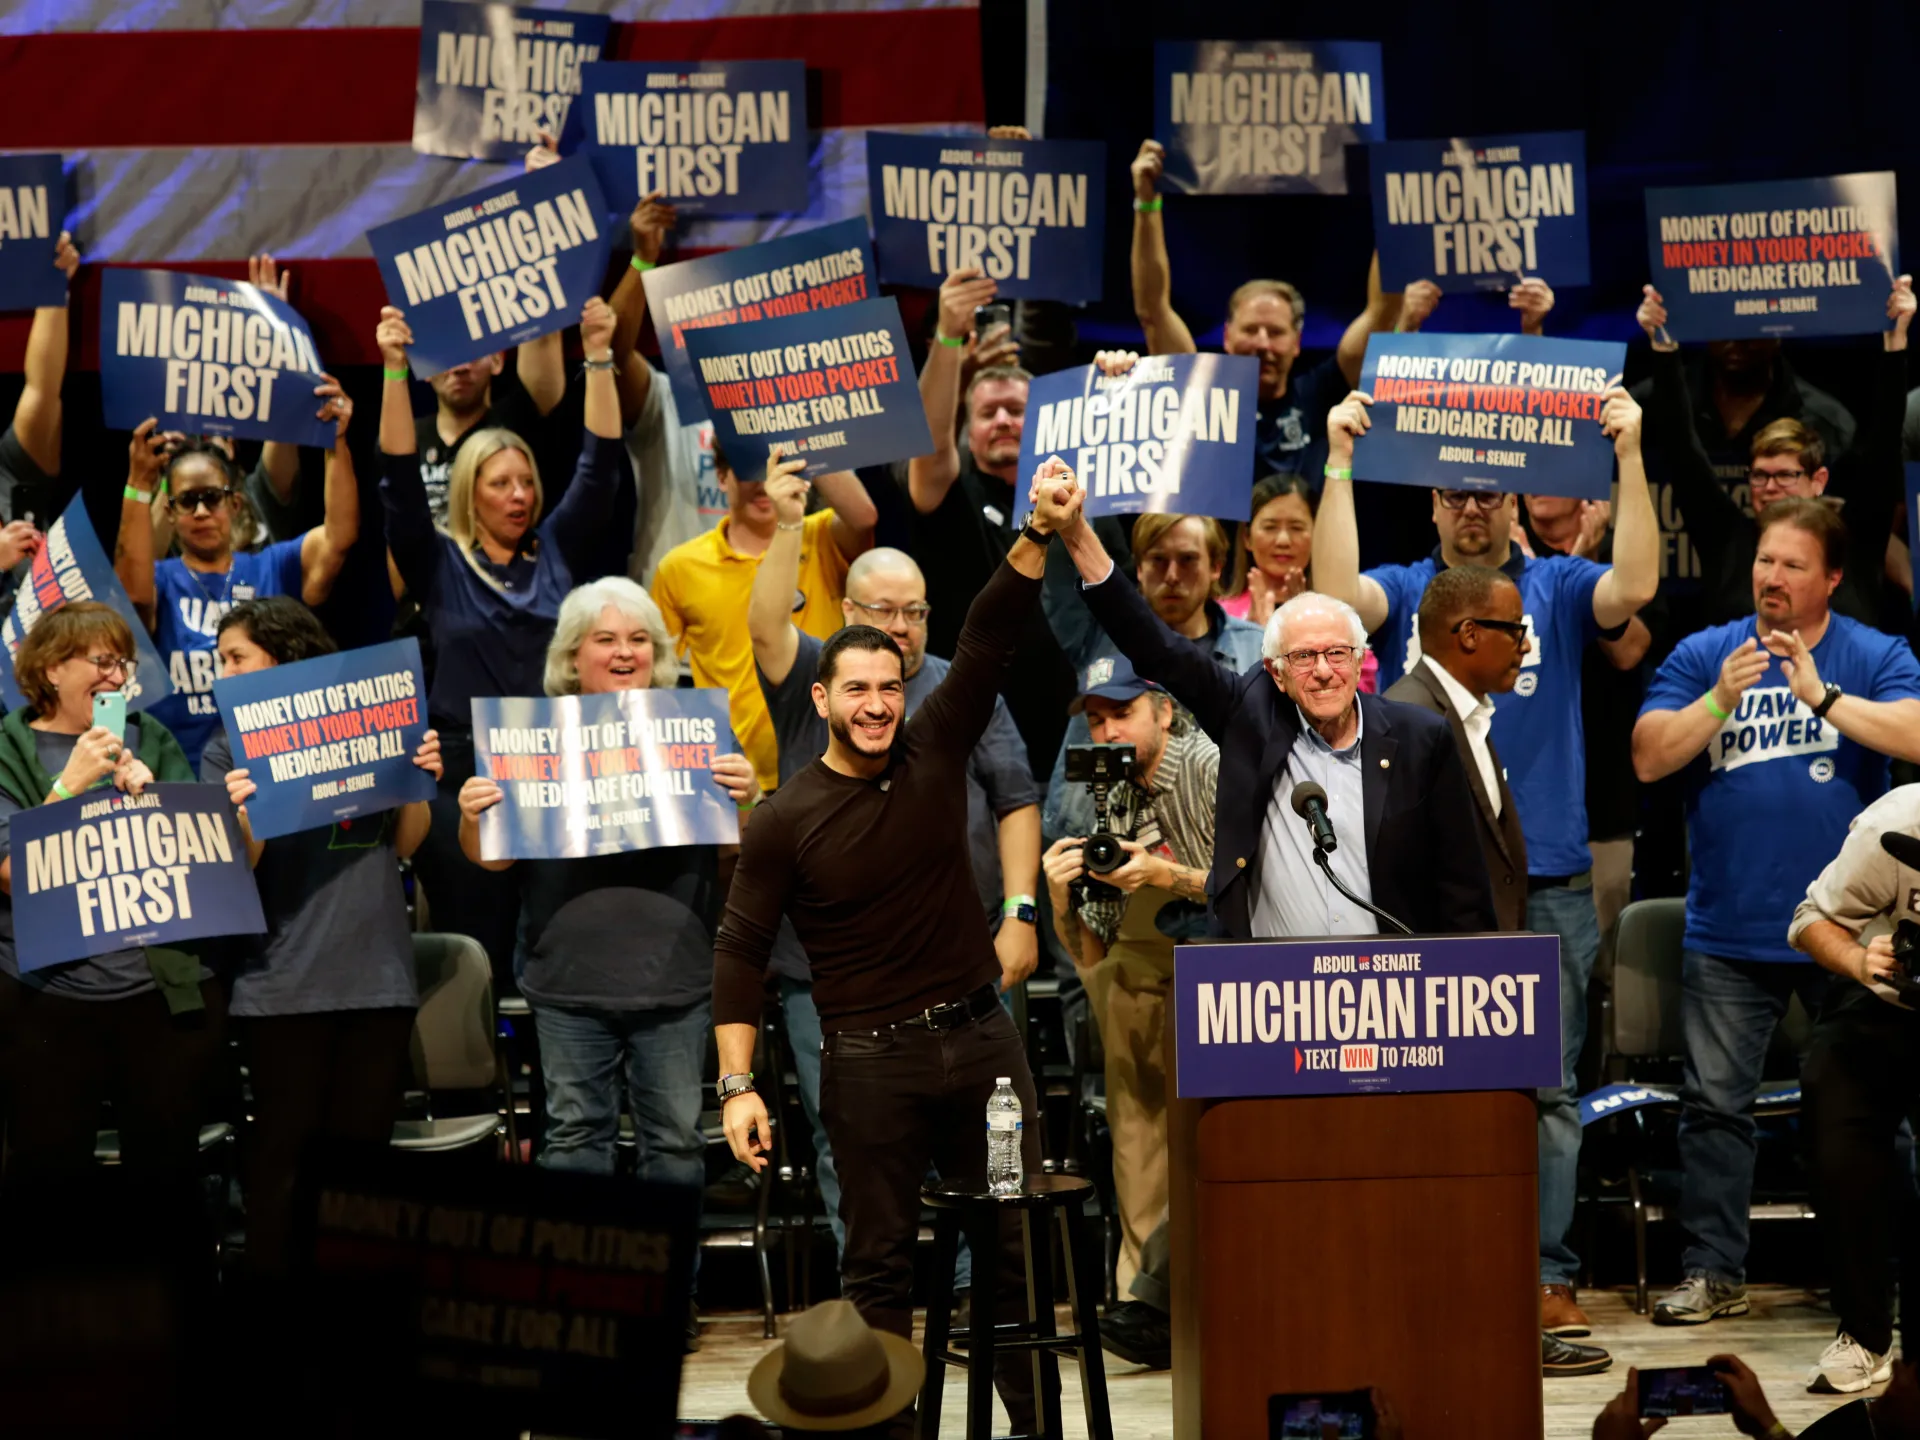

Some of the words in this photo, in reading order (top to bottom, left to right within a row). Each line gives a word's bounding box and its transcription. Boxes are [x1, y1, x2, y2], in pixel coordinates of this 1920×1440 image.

[594, 91, 790, 145] MICHIGAN
[1171, 71, 1373, 124] MICHIGAN
[636, 144, 743, 197] FIRST
[1218, 124, 1327, 176] FIRST
[882, 164, 1088, 228] MICHIGAN
[1385, 163, 1575, 224] MICHIGAN
[394, 188, 598, 306] MICHIGAN
[927, 222, 1036, 280] FIRST
[1433, 217, 1538, 276] FIRST
[1660, 214, 1729, 242] MONEY
[1730, 212, 1767, 240] OUT
[1770, 210, 1796, 237] OF
[1662, 241, 1730, 268] MONEY
[1733, 240, 1753, 265] IN
[1755, 236, 1808, 263] YOUR
[1810, 231, 1881, 260] POCKET
[457, 256, 568, 341] FIRST
[664, 282, 733, 322] MONEY
[734, 272, 770, 303] OUT
[770, 267, 794, 296] OF
[799, 247, 864, 290] POLITICS
[811, 274, 867, 308] POCKET
[1688, 263, 1786, 294] MEDICARE
[1789, 261, 1825, 289] FOR
[1827, 260, 1861, 286] ALL
[117, 301, 321, 375] MICHIGAN
[699, 353, 751, 383] MONEY
[751, 349, 782, 378] OUT
[784, 343, 809, 373] OF
[810, 329, 894, 369] POLITICS
[165, 358, 279, 422] FIRST
[707, 380, 755, 409] MONEY
[756, 378, 775, 405] IN
[776, 369, 826, 401] YOUR
[826, 356, 900, 392] POCKET
[1373, 377, 1447, 407] MONEY
[1447, 381, 1467, 409] IN
[1471, 384, 1523, 414] YOUR
[1526, 388, 1602, 420] POCKET
[1377, 355, 1450, 381] MONEY
[1450, 358, 1490, 384] OUT
[1491, 360, 1516, 386] OF
[1517, 363, 1607, 392] POLITICS
[731, 397, 811, 435] MEDICARE
[811, 393, 848, 425] FOR
[851, 388, 884, 417] ALL
[1034, 386, 1239, 456] MICHIGAN
[1396, 406, 1497, 440] MEDICARE
[1500, 415, 1537, 443] FOR
[1540, 418, 1574, 446] ALL
[807, 431, 847, 450] SENATE
[1439, 446, 1475, 464] ABDUL
[1487, 449, 1526, 468] SENATE
[233, 696, 294, 732] MONEY
[294, 688, 327, 720] OUT
[326, 684, 346, 712] OF
[346, 670, 416, 711] POLITICS
[1734, 692, 1799, 722] UAW
[241, 723, 301, 759] MONEY
[300, 720, 319, 746] IN
[319, 711, 363, 743] YOUR
[362, 698, 418, 734] POCKET
[489, 727, 558, 754] MONEY
[602, 722, 627, 748] OF
[1721, 717, 1823, 760] POWER
[269, 743, 351, 782] MEDICARE
[350, 735, 379, 766] FOR
[380, 730, 405, 759] ALL
[491, 755, 560, 781] MONEY
[588, 748, 641, 777] YOUR
[81, 799, 114, 820] ABDUL
[123, 793, 162, 811] SENATE
[312, 782, 339, 800] ABDUL
[346, 772, 375, 793] SENATE
[26, 813, 233, 894] MICHIGAN
[76, 866, 192, 937] FIRST
[1313, 955, 1357, 974] ABDUL
[1372, 953, 1421, 972] SENATE
[1197, 977, 1416, 1044] MICHIGAN
[1425, 974, 1540, 1038] FIRST
[1304, 1048, 1337, 1070] TEXT
[1344, 1047, 1373, 1068] WIN
[1381, 1046, 1398, 1068] TO
[1400, 1045, 1444, 1068] 74801
